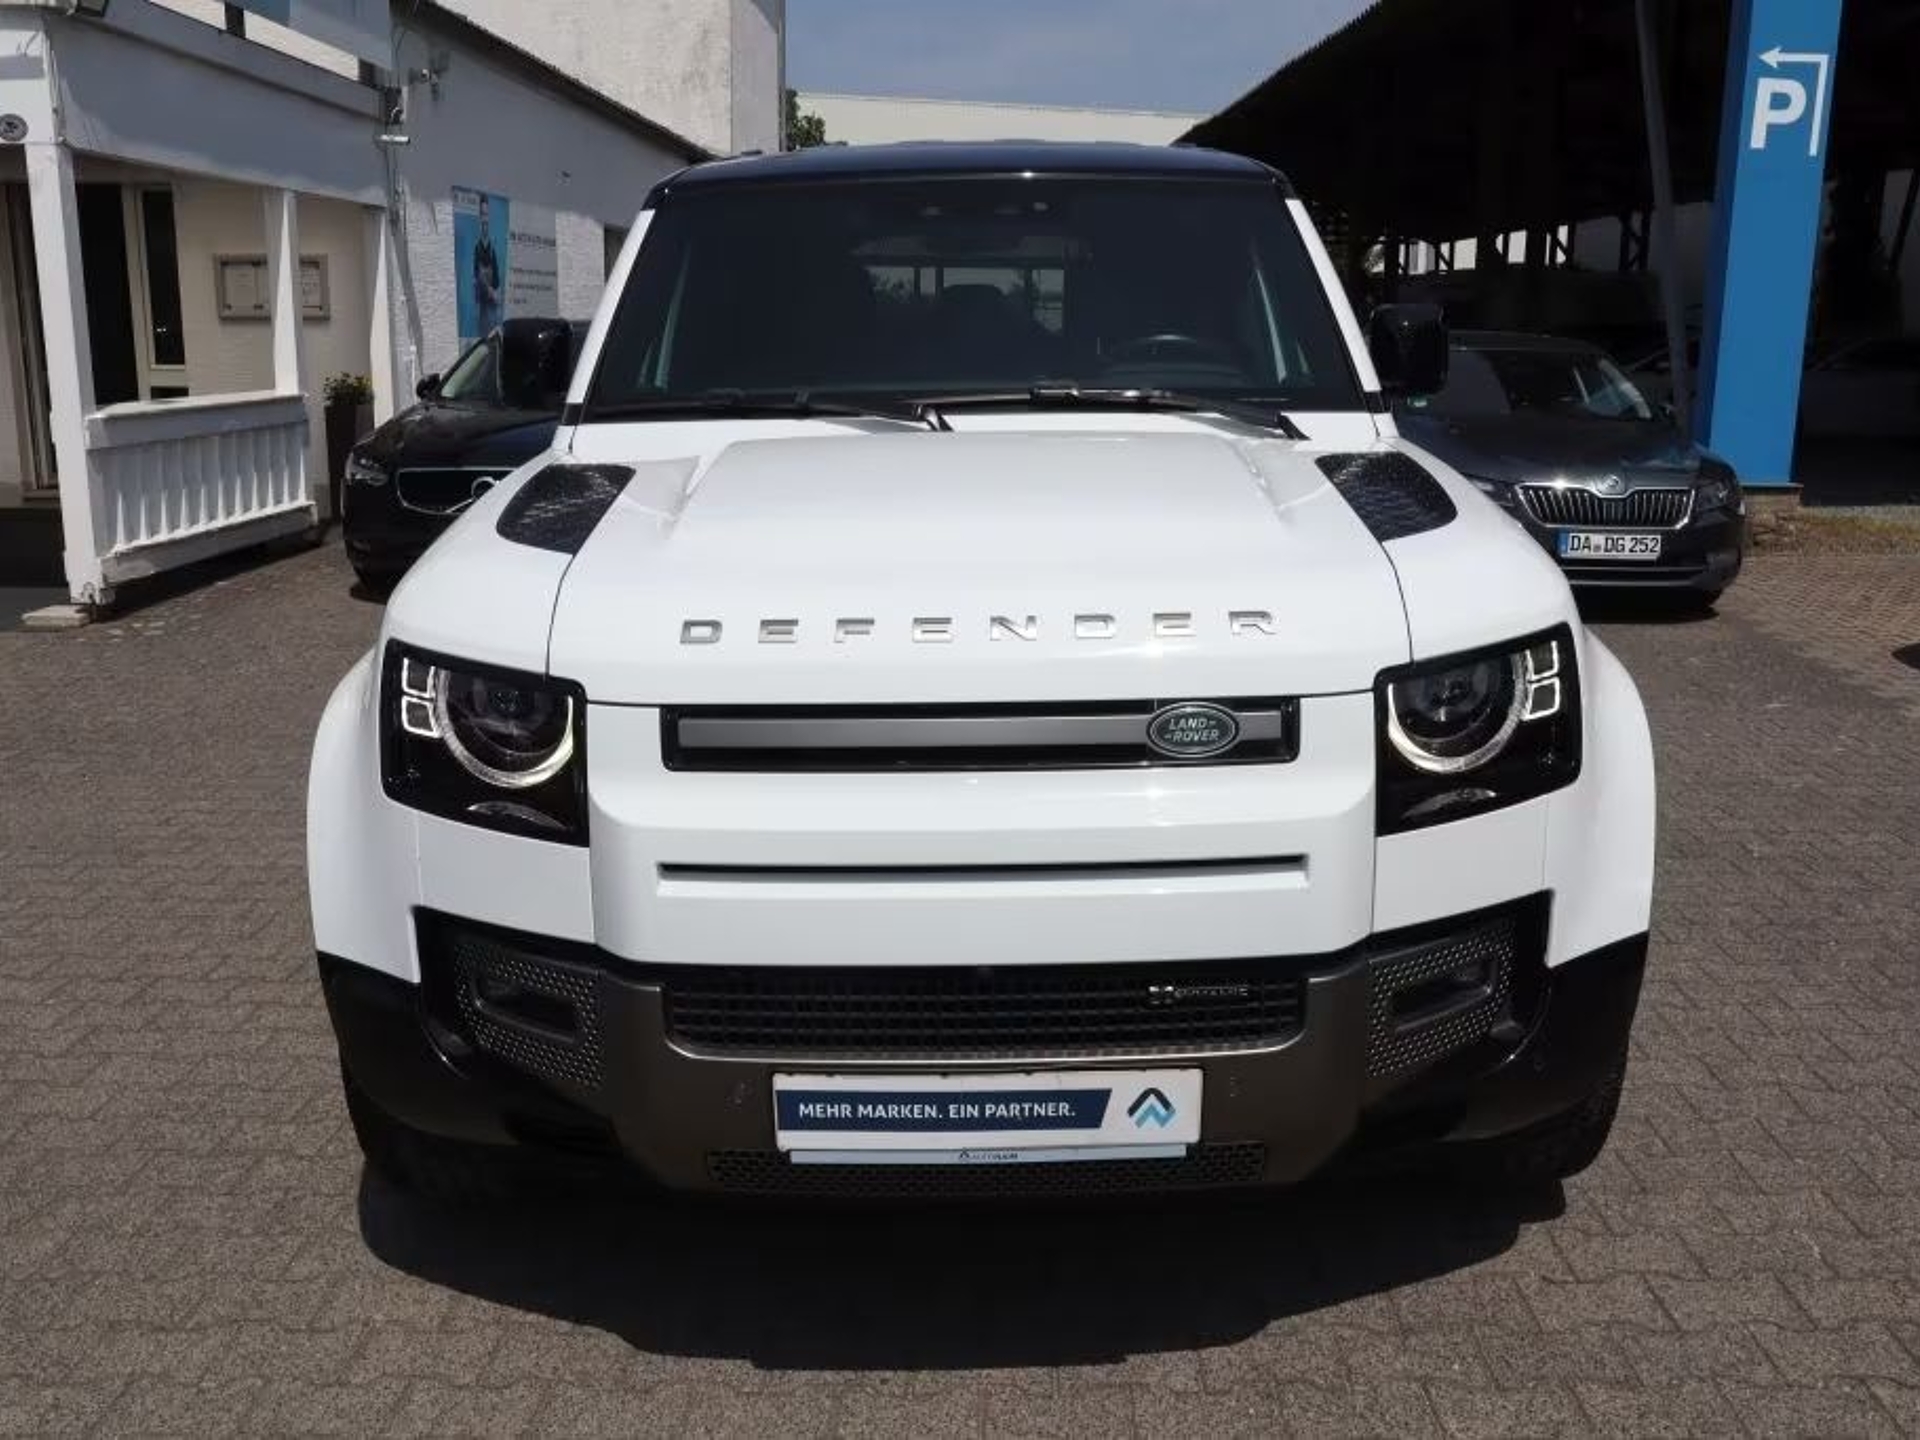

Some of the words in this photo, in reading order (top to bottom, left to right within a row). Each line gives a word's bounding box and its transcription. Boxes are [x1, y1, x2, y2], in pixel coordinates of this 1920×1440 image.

[1750, 77, 1807, 149] P
[1569, 535, 1592, 551] DA
[1603, 536, 1626, 553] DG
[1628, 537, 1660, 553] 252
[680, 610, 1277, 645] DEFENDER
[799, 1103, 852, 1119] MEHR
[857, 1104, 943, 1119] MARKEN.
[948, 1104, 979, 1118] EIN
[985, 1102, 1076, 1118] PARTNER.
